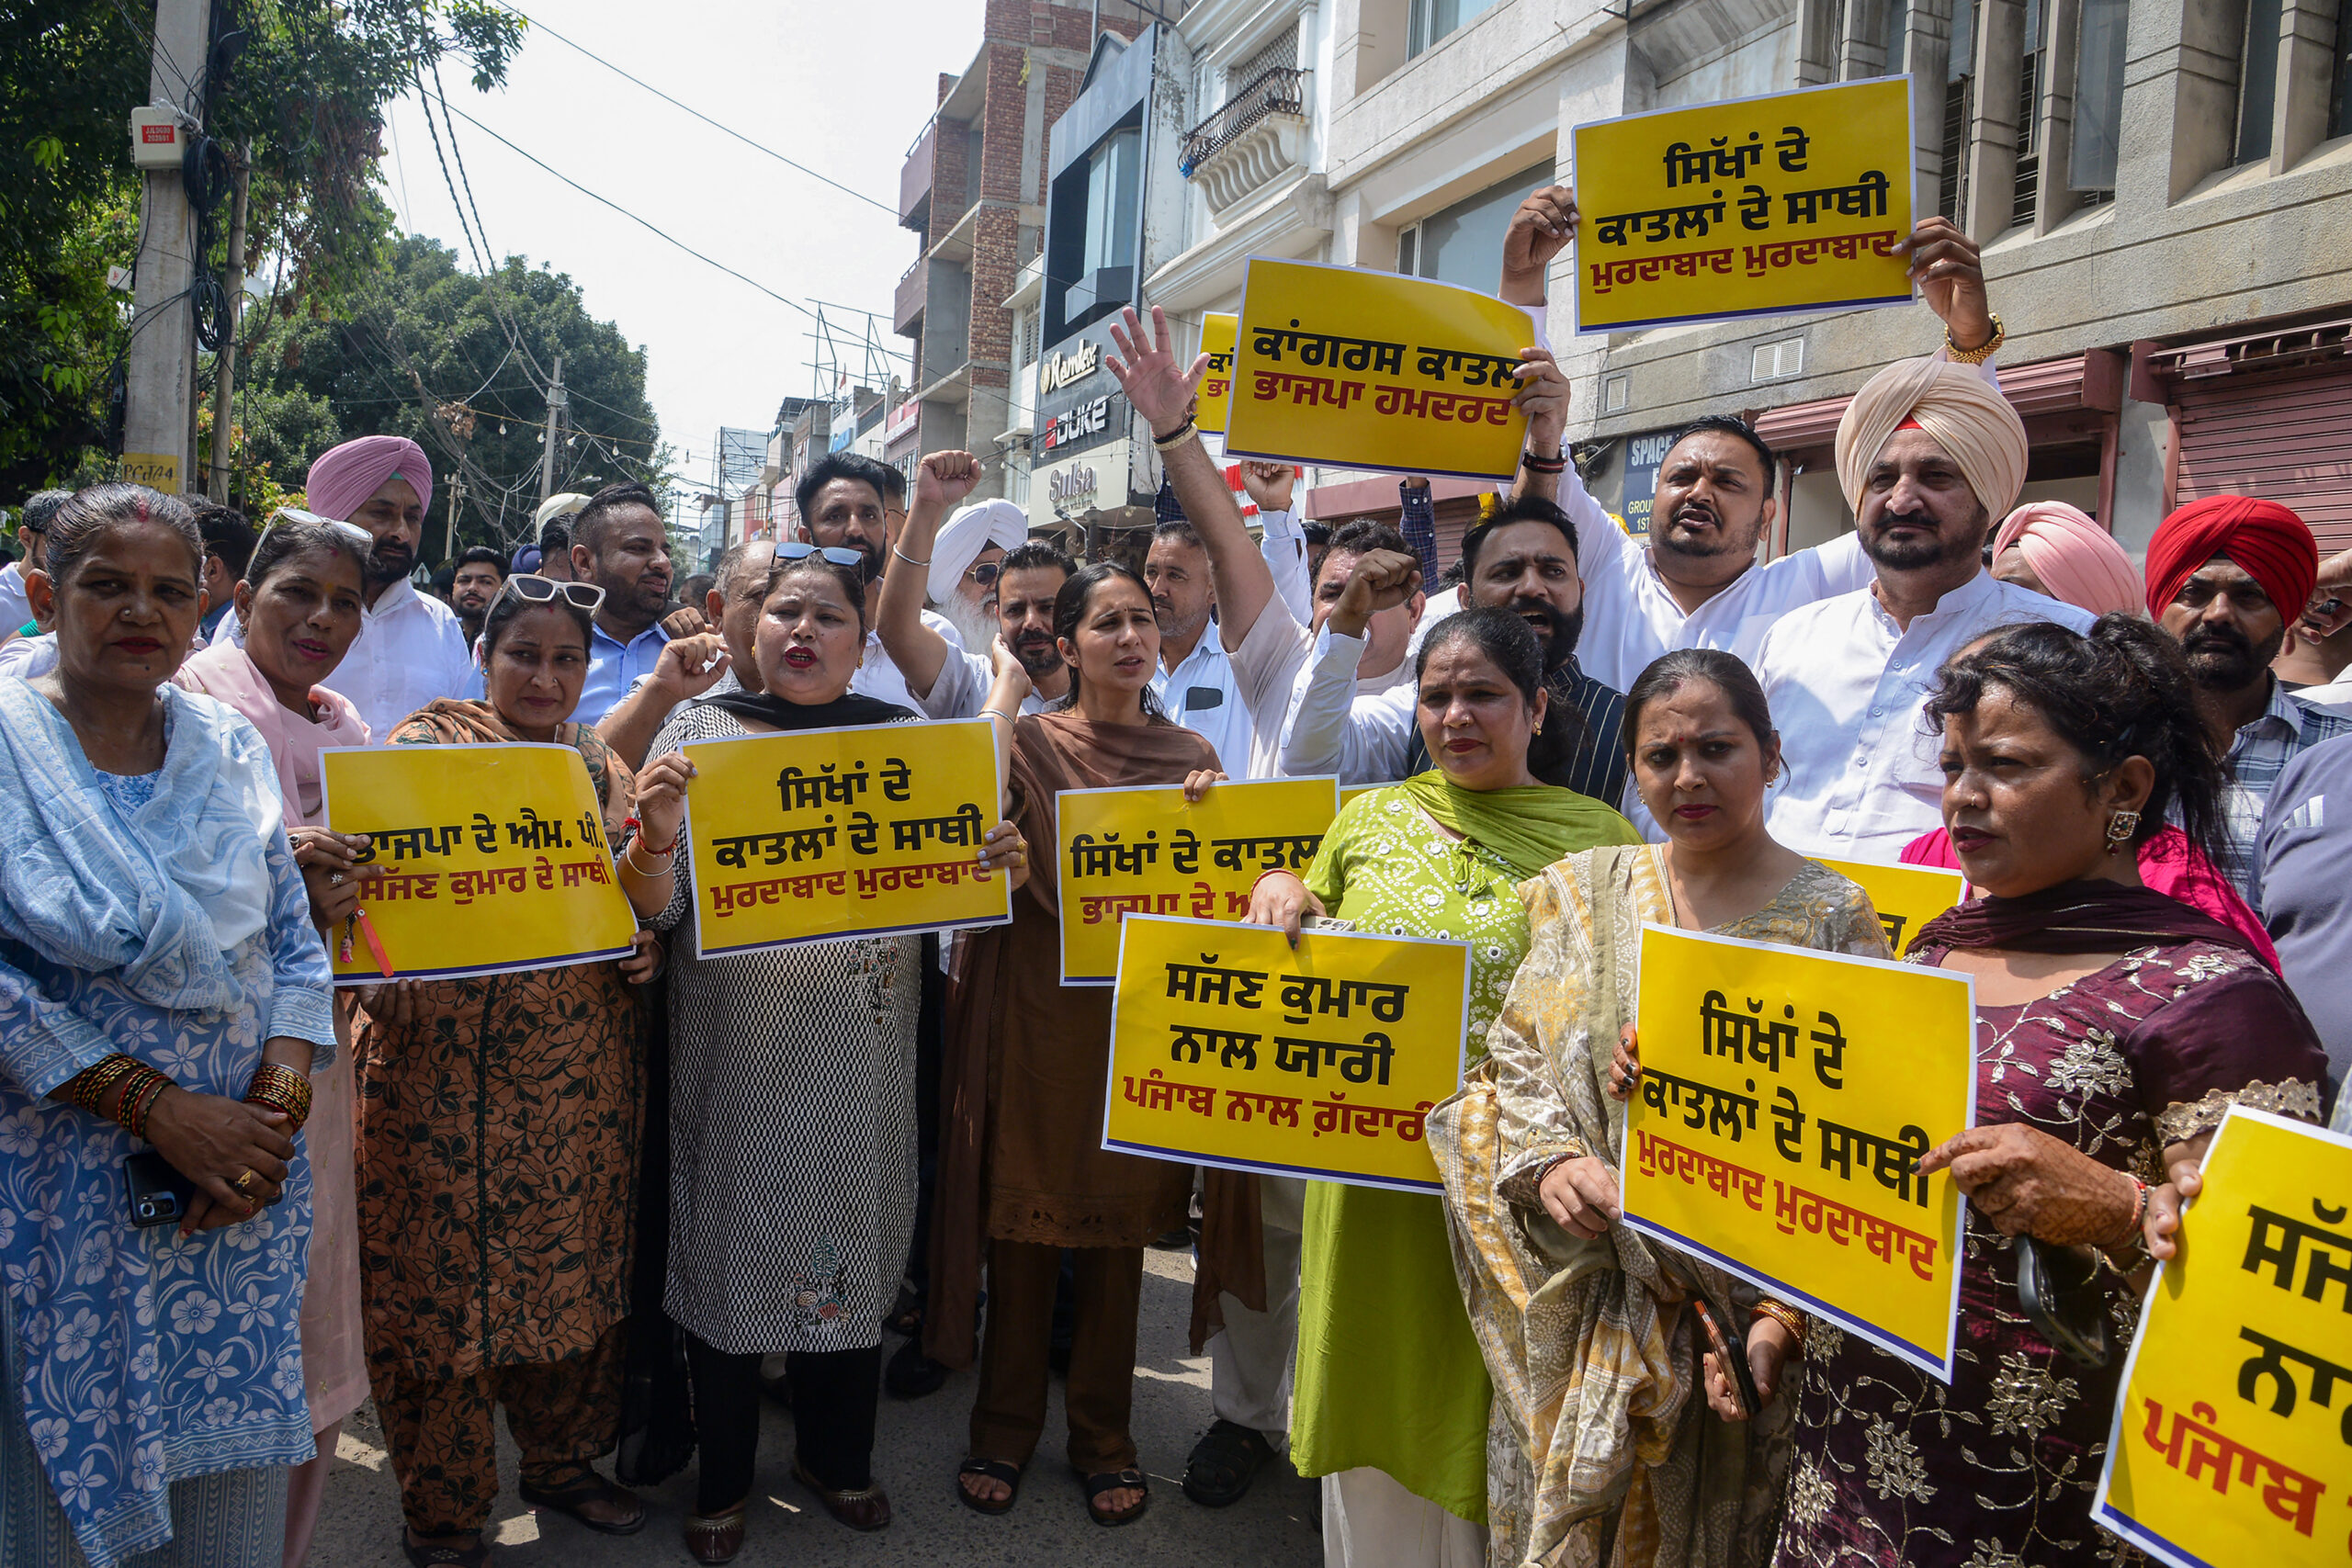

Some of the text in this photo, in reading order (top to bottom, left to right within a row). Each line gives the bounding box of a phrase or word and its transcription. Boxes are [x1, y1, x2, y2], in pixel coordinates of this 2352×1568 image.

[1663, 127, 1810, 187] ਸਿੱਖਾਂ ਦੇ
[1595, 170, 1890, 246] ਕਾਤਲਾਂ ਦੇ ਸਾਥੀ
[1590, 231, 1897, 294] ਮੁਰਦਾਬਾਦ ਮੁਰਦਾਬਾਦ
[1253, 319, 1406, 375] ਕਾਂਗਰਸ
[1253, 370, 1511, 426] ਭਾਜਪਾ ਹਮਦਰਦ
[777, 758, 911, 811] ਸਿੱਖਾਂ ਦੇ
[471, 814, 498, 853] ਦੇ
[712, 804, 982, 869] ਕਾਤਲਾਂ ਦੇ ਸਾਥੀ
[1070, 830, 1159, 877] ਸਿੱਖਾਂ
[1170, 829, 1201, 874] ਦੇ
[358, 853, 610, 905] ਸੱਜਣ ਕੁਮਾਰ ਦੇ ਸਾਥੀ
[710, 860, 991, 918] ਮੁਰਦਾਬਾਦ ਮੁਰਦਾਬਾਦ
[1190, 882, 1216, 919] ਦੇ
[1165, 953, 1409, 1024] ਸੱਜਣ ਕੁਮਾਰ
[1170, 1024, 1396, 1085] ਨਾਲ ਯਾਰੀ
[1700, 989, 1847, 1089] ਸਿੱਖਾਂ ਦੇ
[1123, 1069, 1216, 1117] ਪੰਜਾਬ
[1226, 1089, 1303, 1128] ਨਾਲ
[1642, 1066, 1930, 1208] ਕਾਤਲਾਂ ਦੇ ਸਾਥੀ
[1636, 1129, 1937, 1281] ਮੁਰਦਾਬਾਦ ਮੁਰਦਾਬਾਦ
[2238, 1325, 2352, 1447] ਨਾ
[2143, 1401, 2326, 1538] ਪੰਜਾਬ
